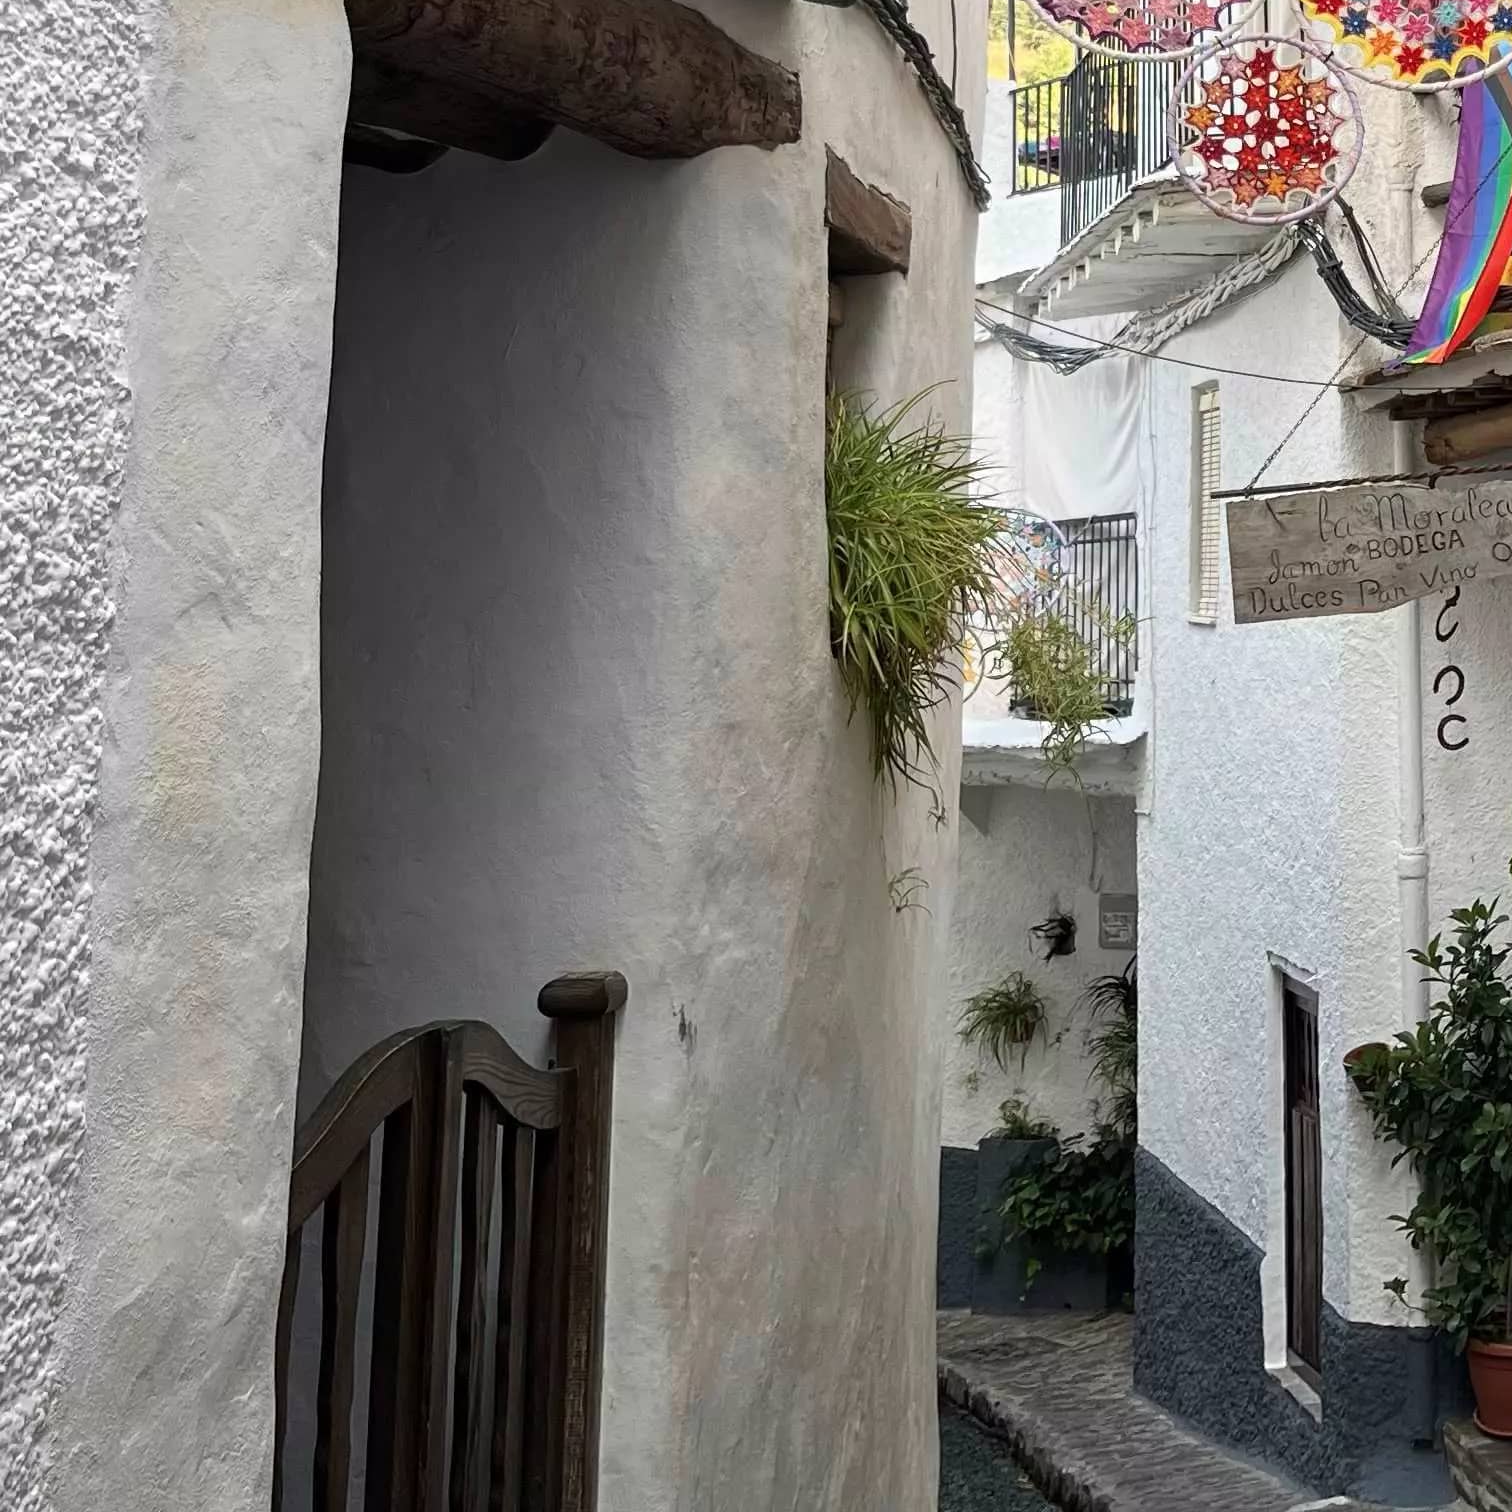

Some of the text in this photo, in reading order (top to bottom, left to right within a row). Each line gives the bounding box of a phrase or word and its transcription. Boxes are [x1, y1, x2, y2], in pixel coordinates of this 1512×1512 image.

[1366, 529, 1465, 560] BODEGA
[1250, 562, 1479, 615] Dulces Pan Vino
